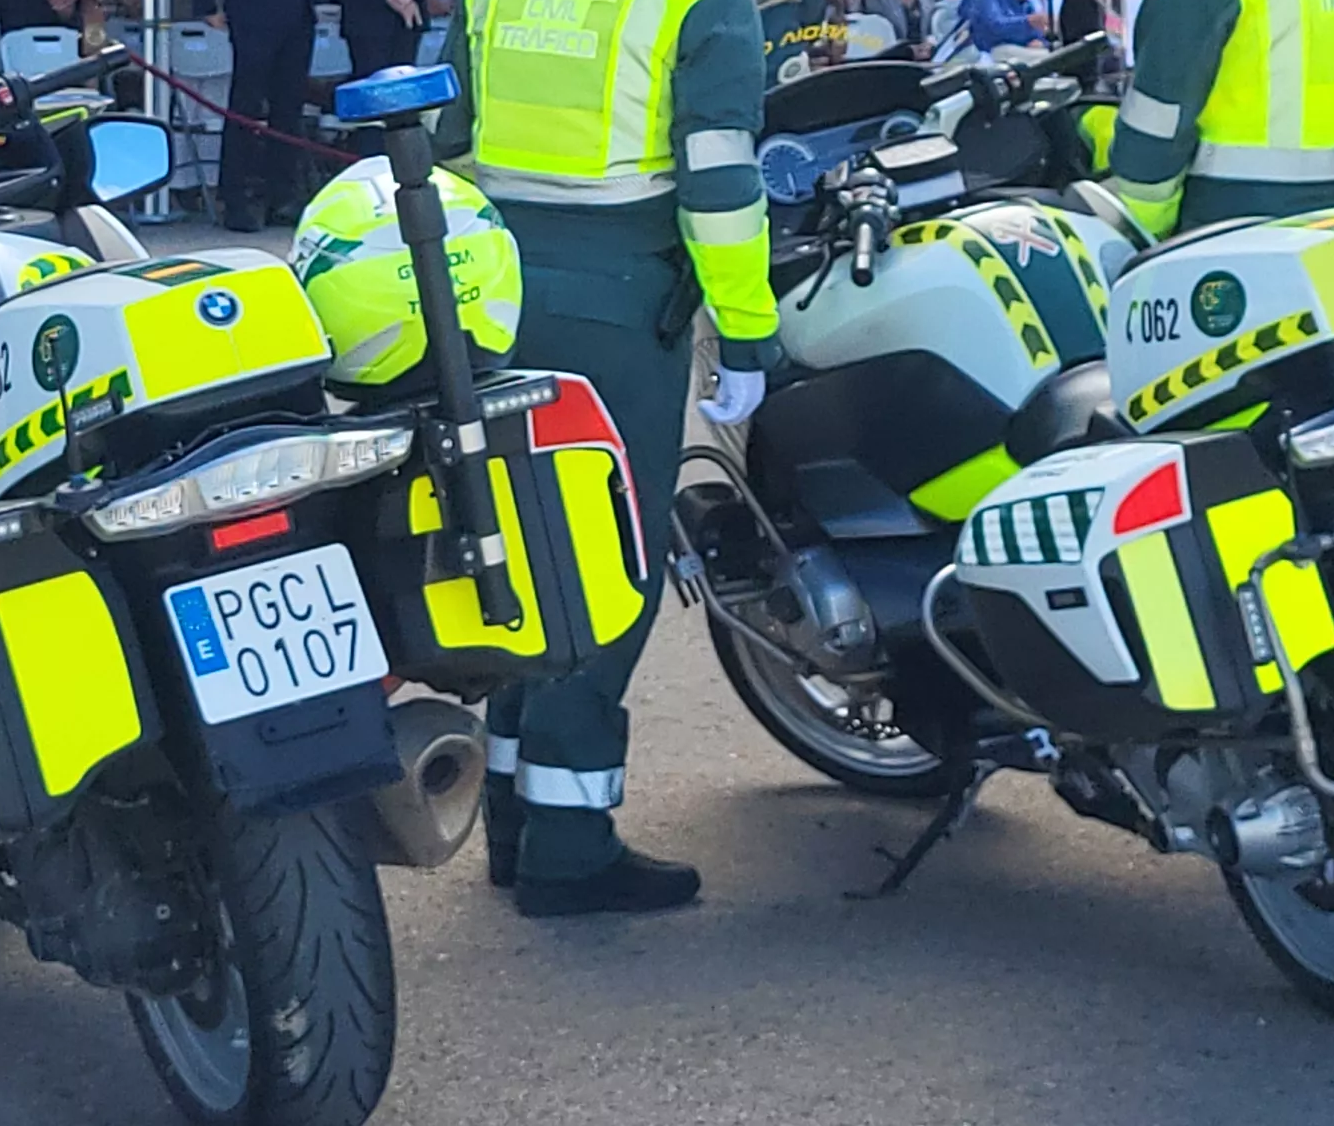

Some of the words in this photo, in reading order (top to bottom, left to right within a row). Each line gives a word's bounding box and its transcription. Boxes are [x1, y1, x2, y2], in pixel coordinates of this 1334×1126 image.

[1141, 297, 1181, 343] 062
[195, 638, 215, 660] E
[236, 618, 358, 697] 0107
